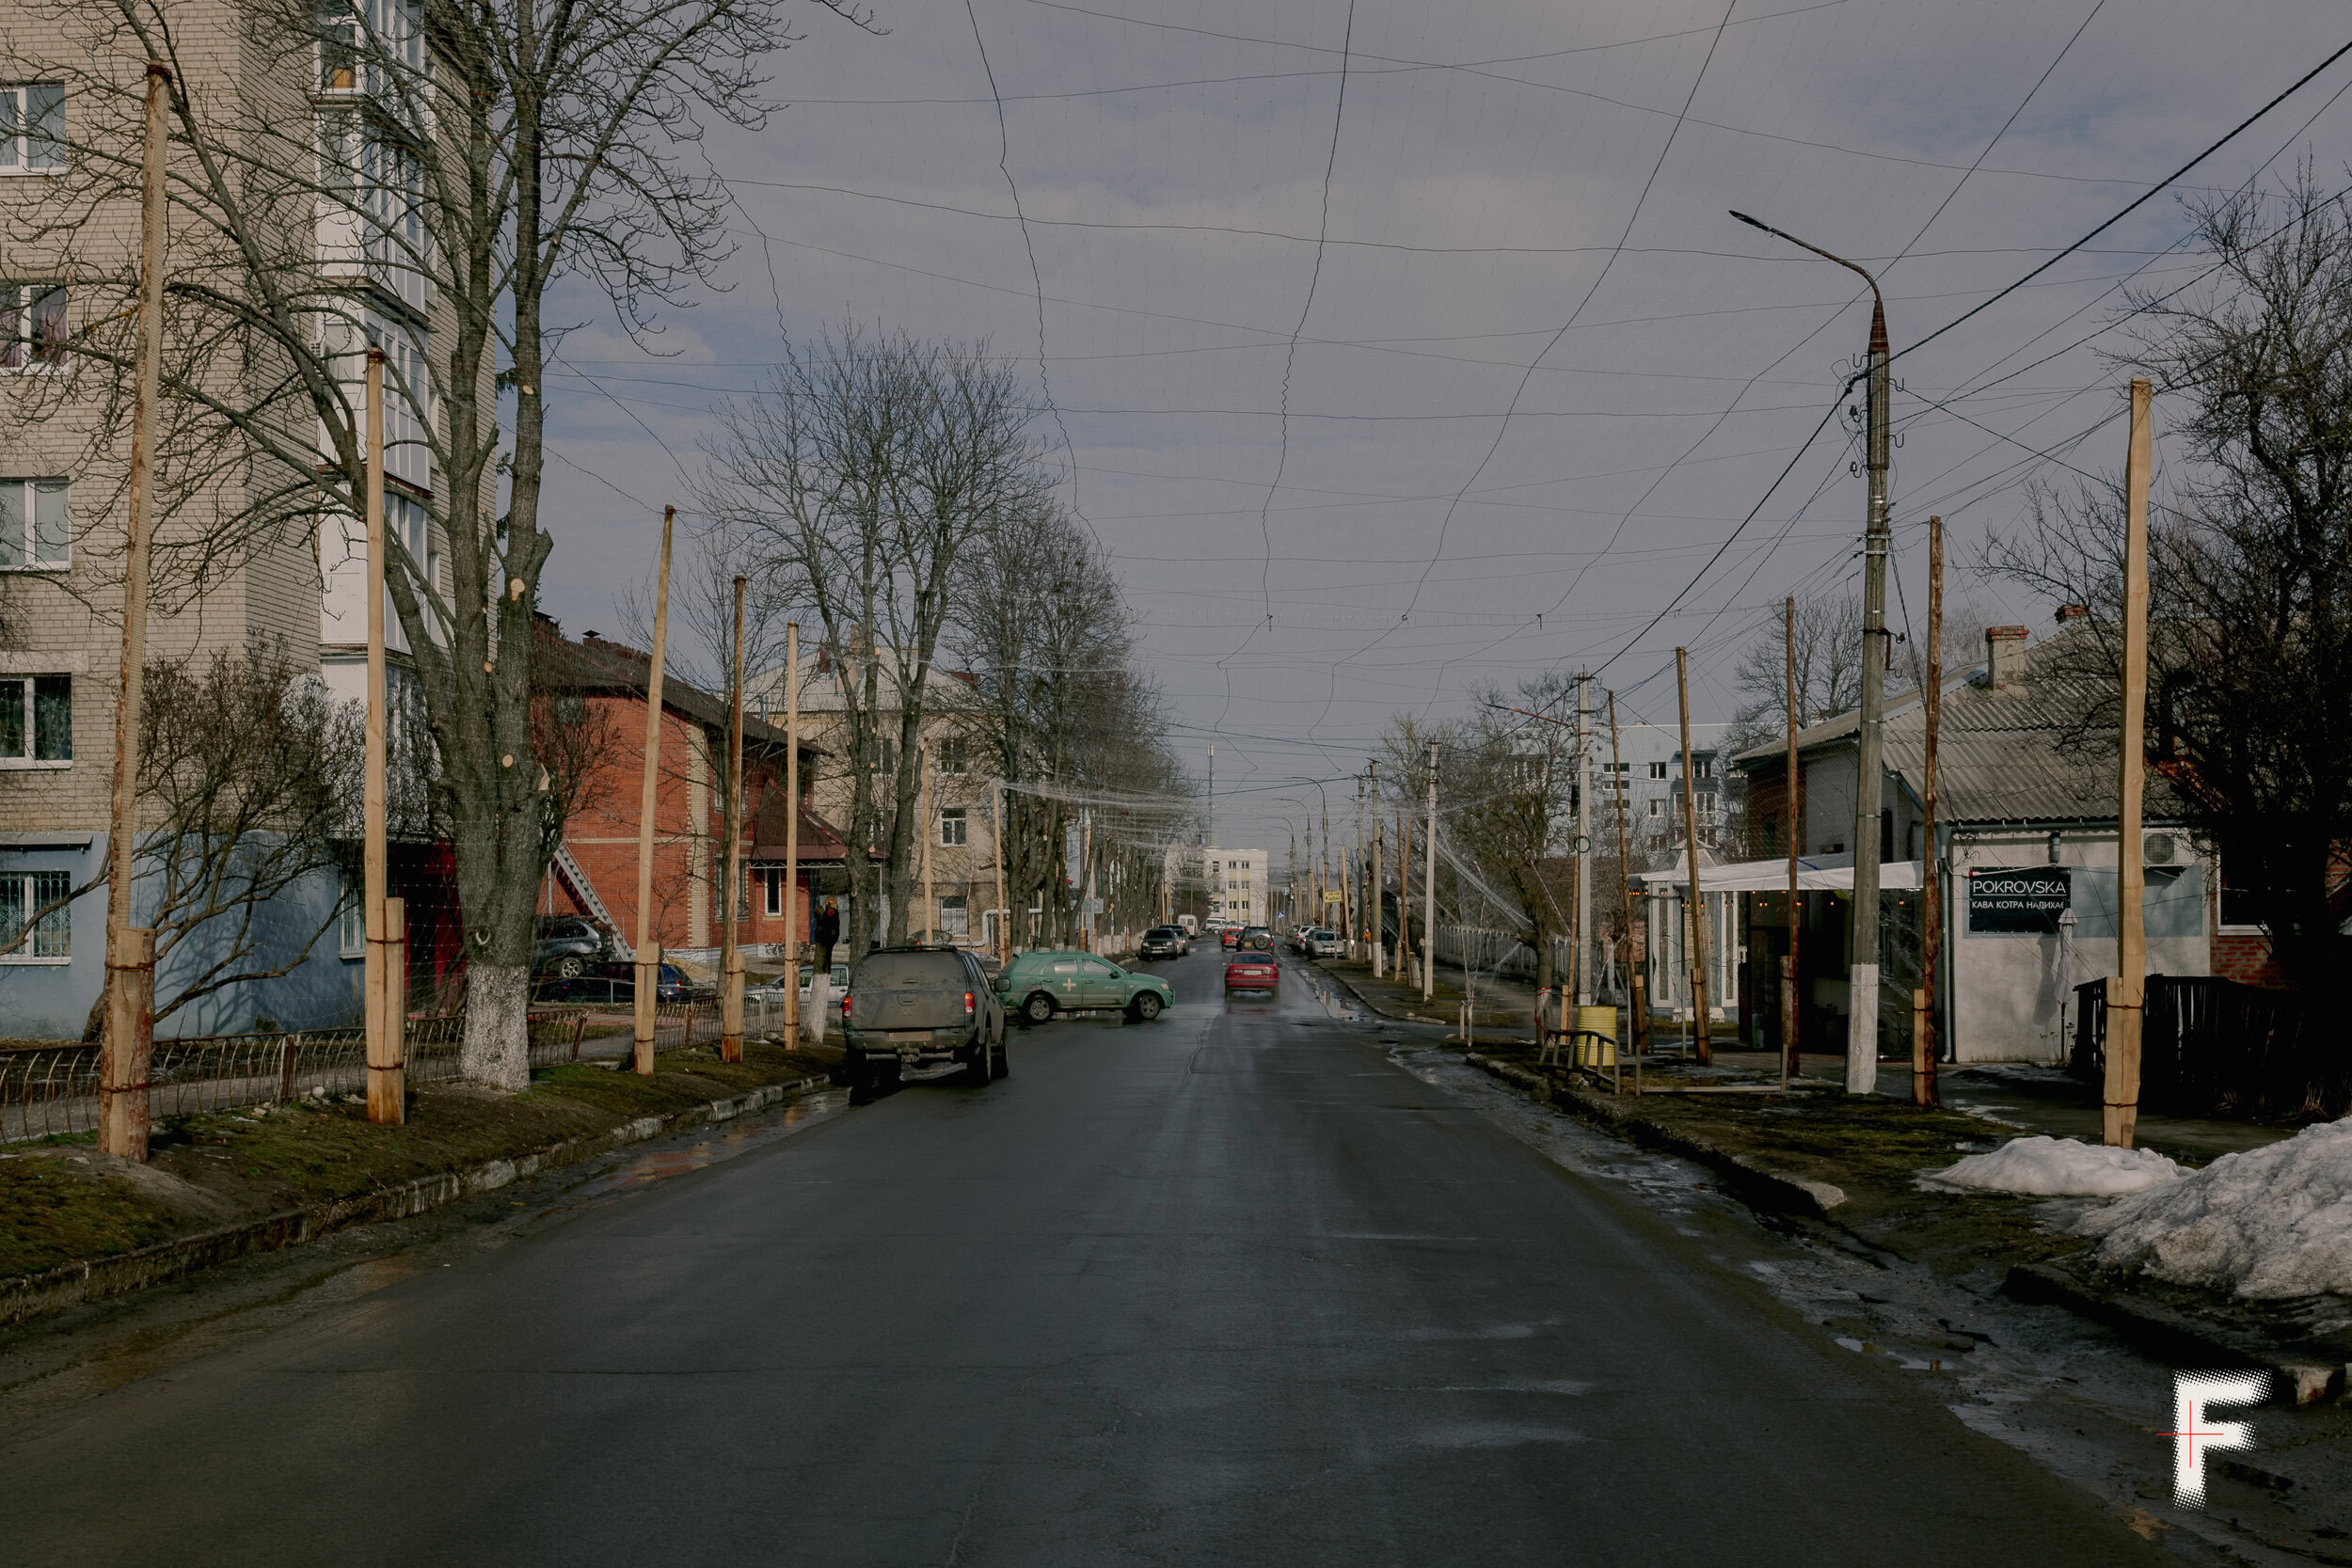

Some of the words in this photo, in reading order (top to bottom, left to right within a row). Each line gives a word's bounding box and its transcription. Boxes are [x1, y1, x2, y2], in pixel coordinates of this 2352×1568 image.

[1973, 880, 2066, 894] POKROVSKA
[1972, 900, 1994, 909] КАВА
[1996, 900, 2024, 909] КОТРА
[2026, 900, 2064, 910] НАДИХАЄ
